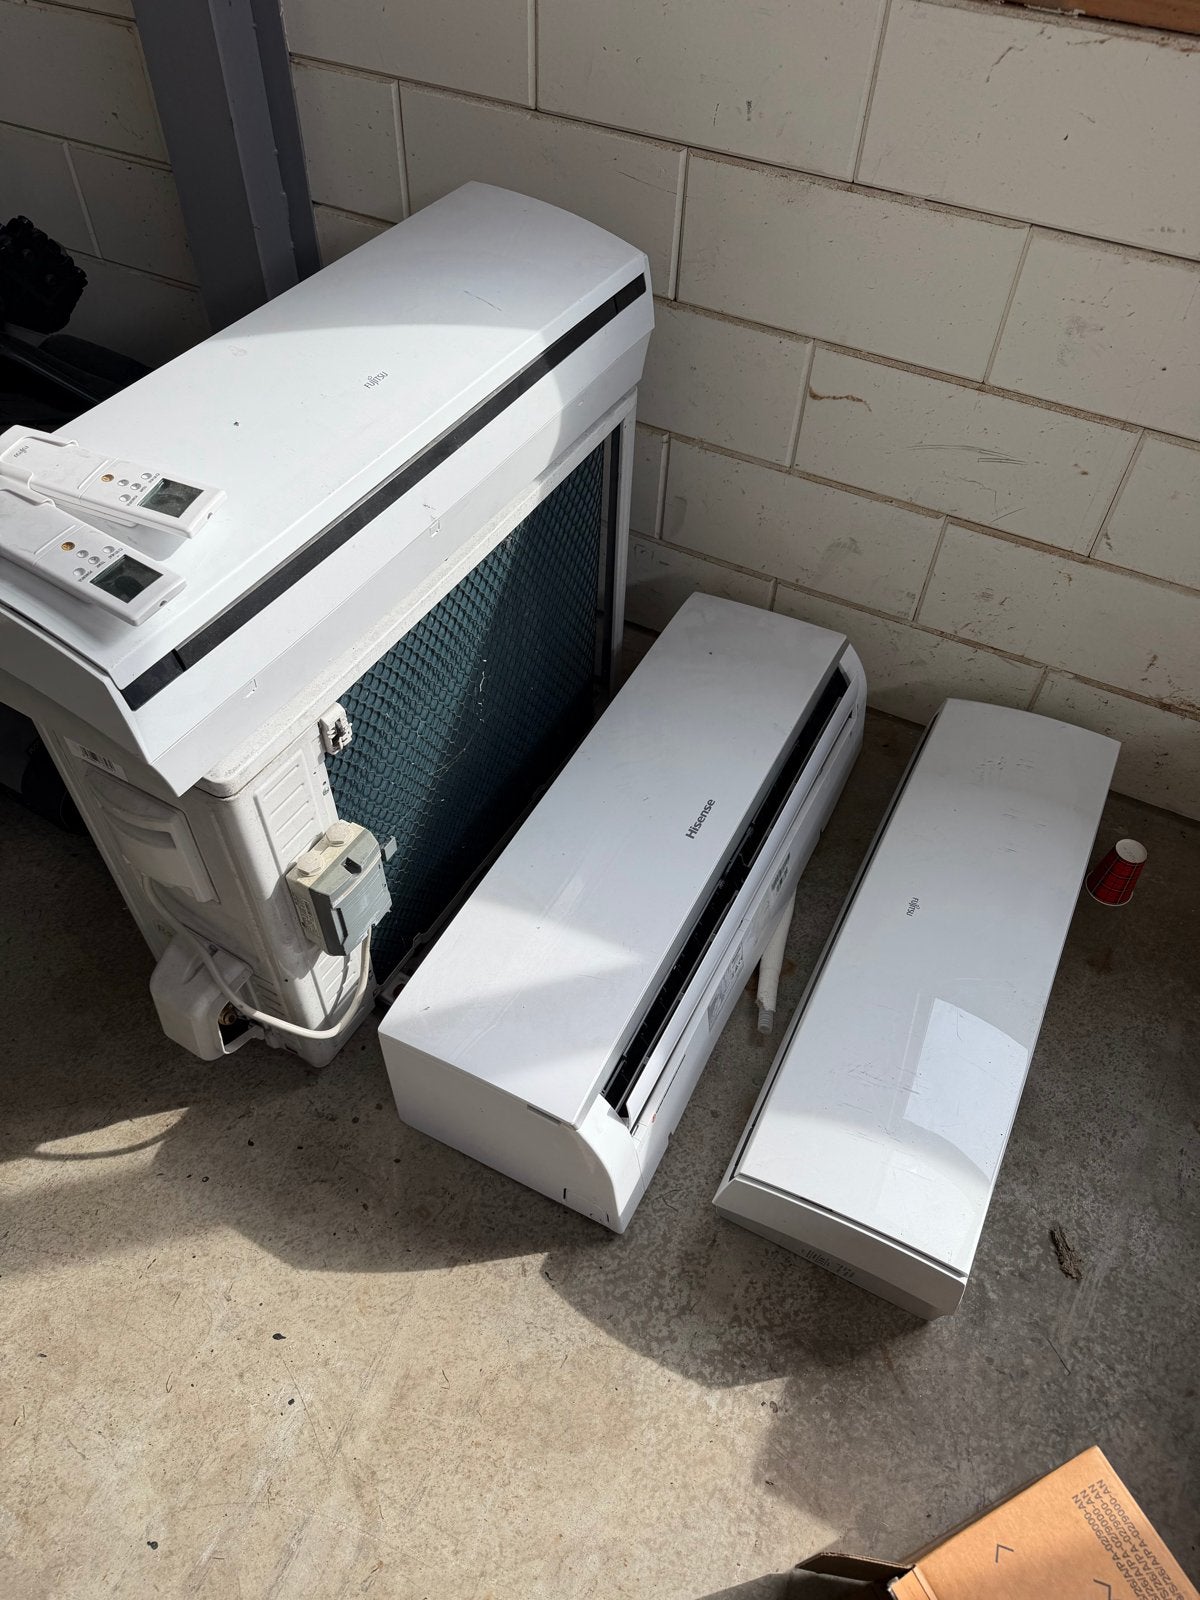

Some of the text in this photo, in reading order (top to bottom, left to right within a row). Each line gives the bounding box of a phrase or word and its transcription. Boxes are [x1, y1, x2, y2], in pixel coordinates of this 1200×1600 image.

[364, 371, 388, 389] FUJITSU
[685, 799, 716, 839] Hisense
[906, 897, 920, 917] FUJITSU
